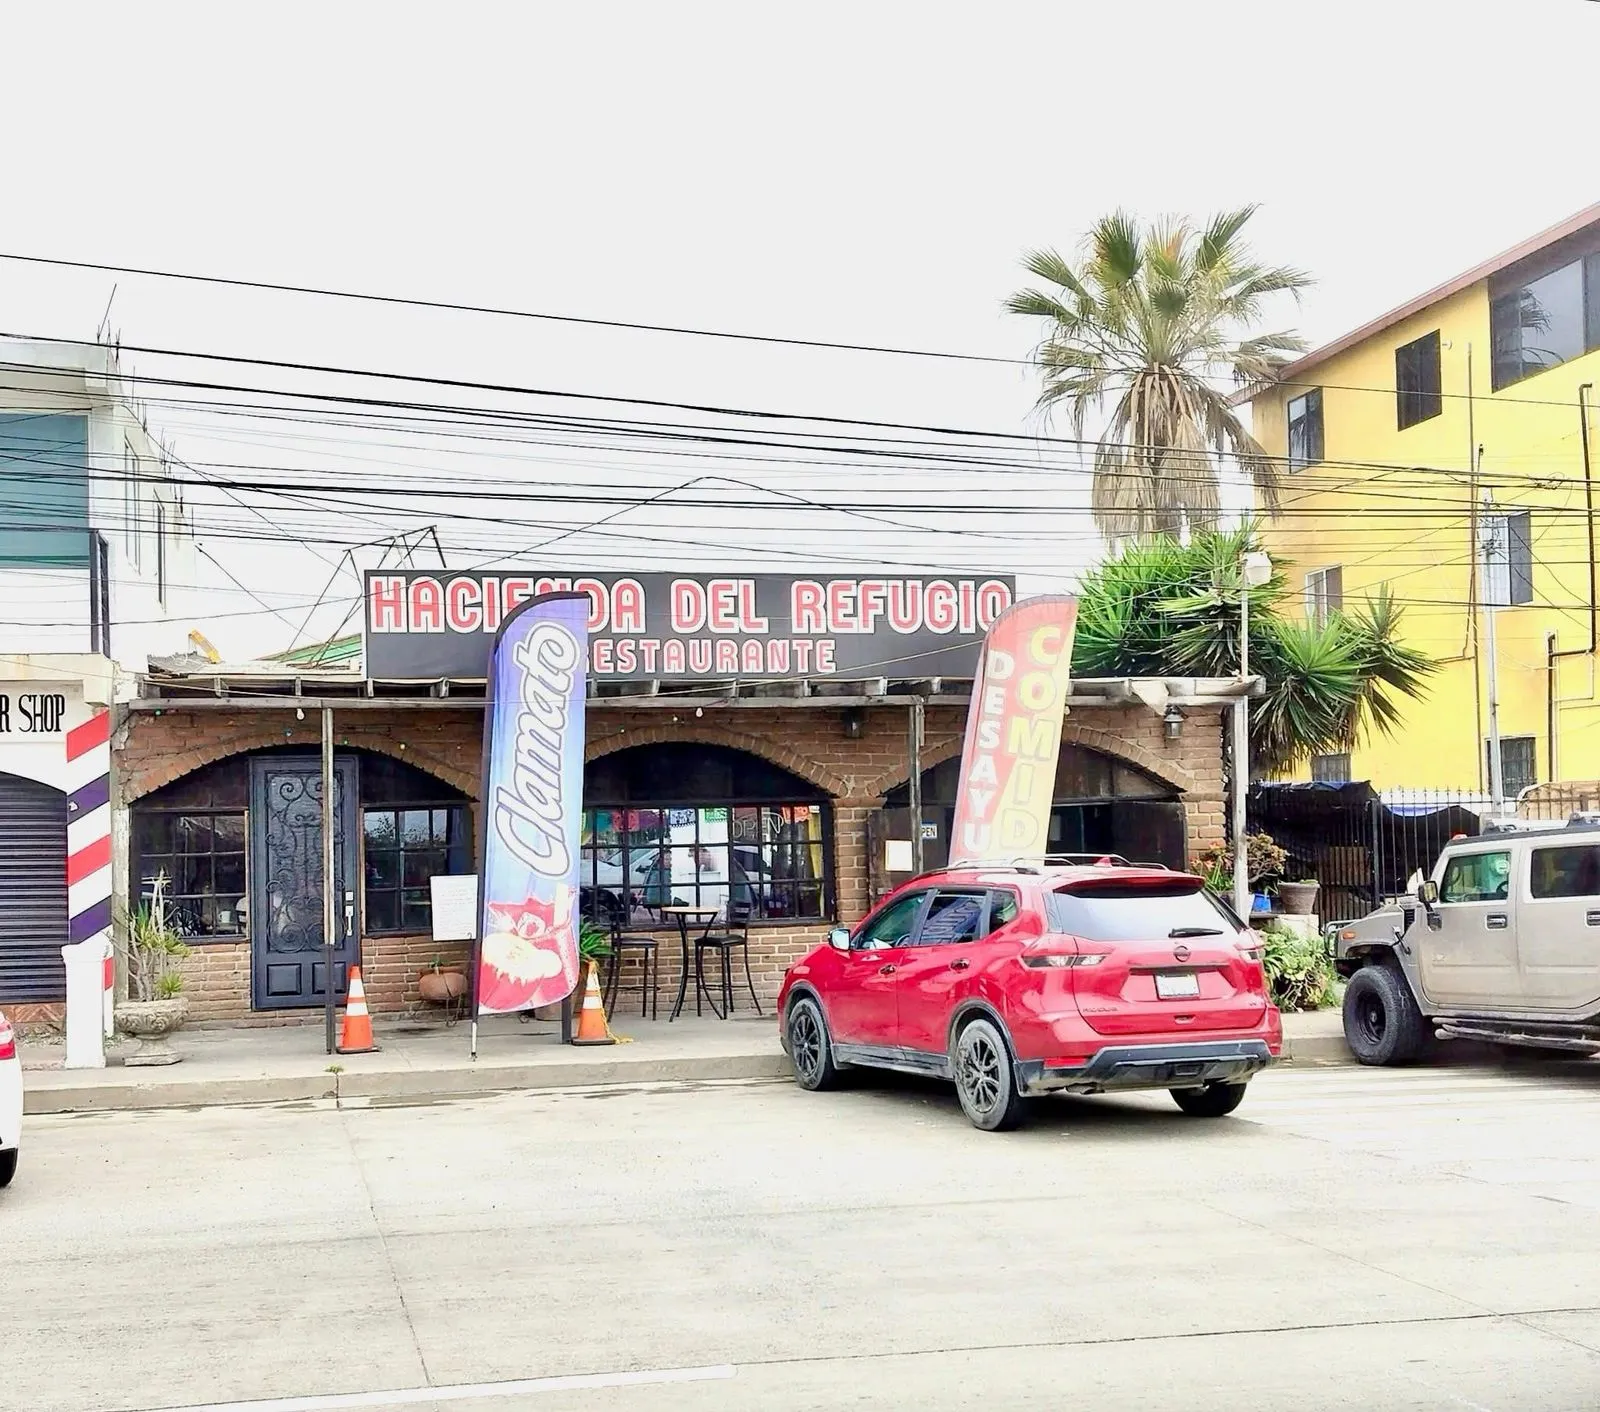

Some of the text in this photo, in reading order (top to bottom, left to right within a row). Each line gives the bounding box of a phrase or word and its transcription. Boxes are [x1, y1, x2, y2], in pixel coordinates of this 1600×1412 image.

[369, 576, 1011, 634] HACIEDA DEL REFUGIO
[586, 638, 837, 674] ESTAURANTE
[18, 694, 66, 732] SHOP
[1000, 625, 1062, 851] COMID
[493, 622, 580, 878] Clamato
[963, 649, 1016, 854] DESAYU
[921, 827, 936, 837] PEN
